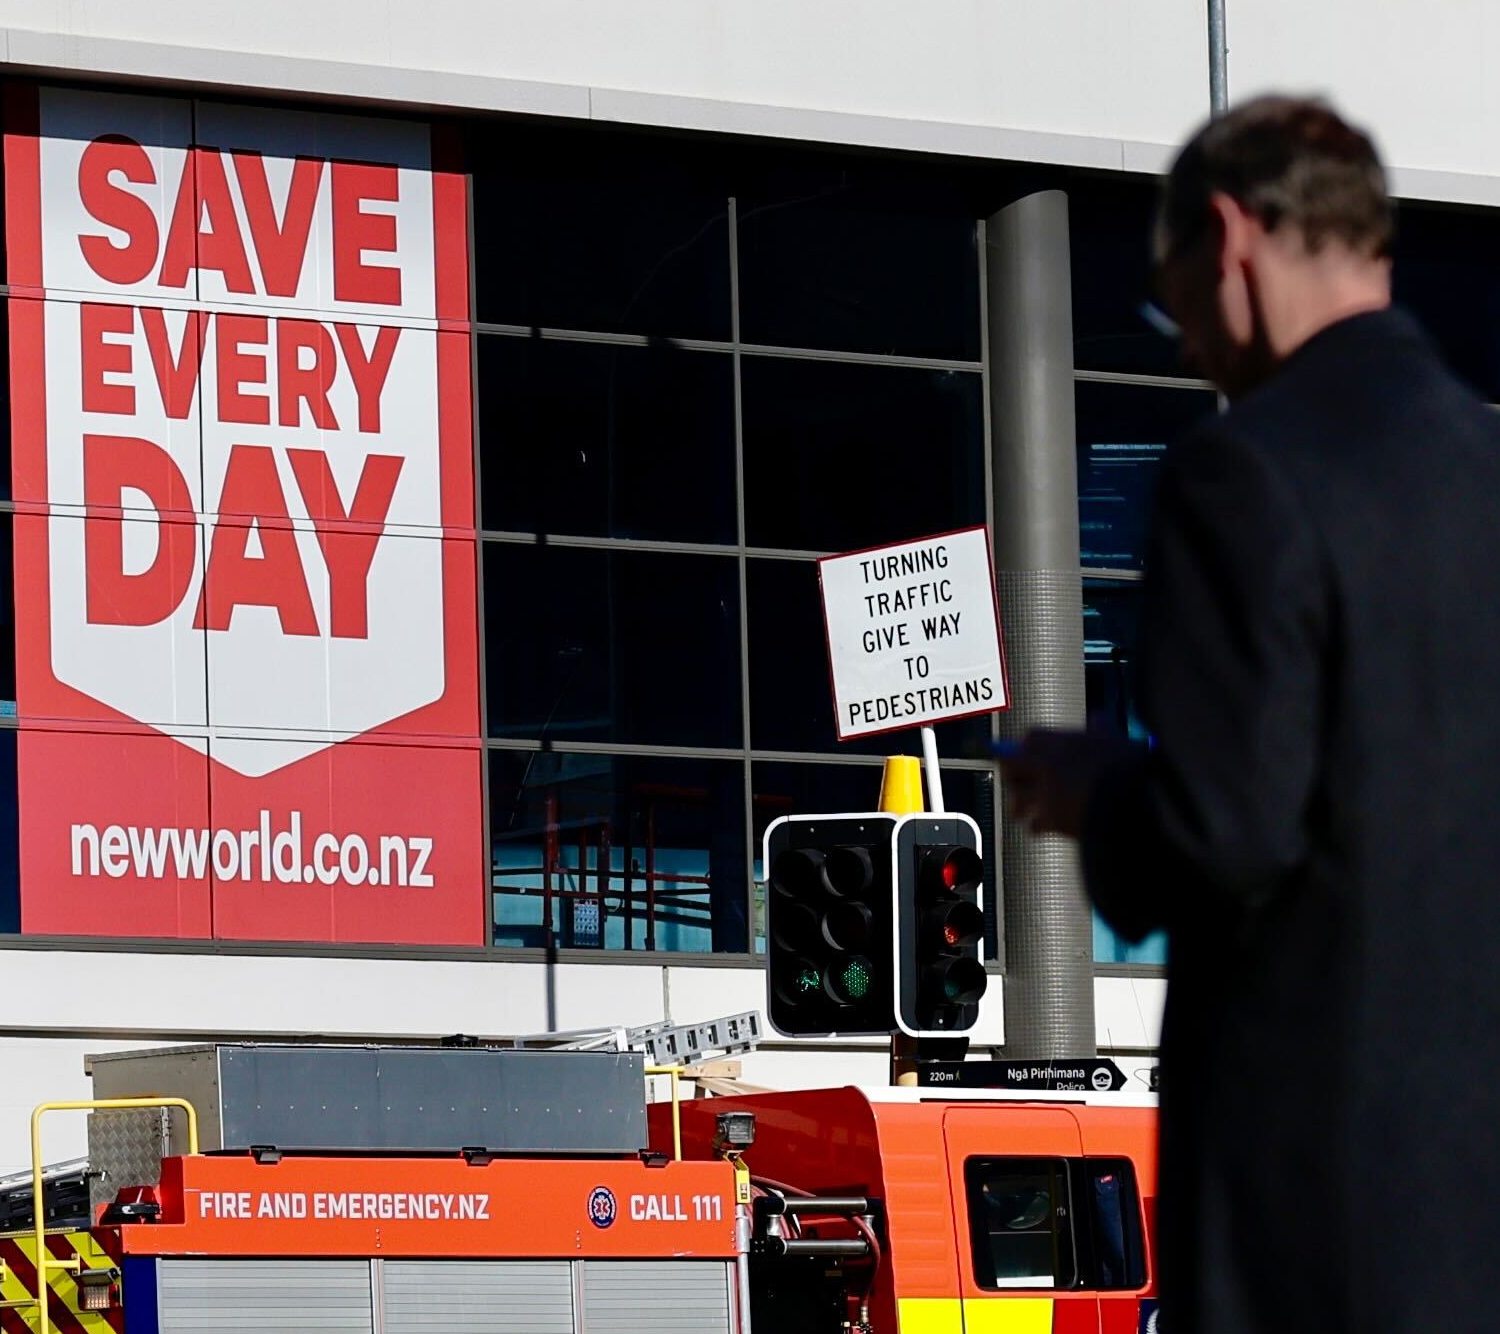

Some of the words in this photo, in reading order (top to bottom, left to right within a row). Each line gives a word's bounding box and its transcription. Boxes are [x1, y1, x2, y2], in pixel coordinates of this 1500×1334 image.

[77, 133, 402, 307] SAVE
[80, 301, 403, 434] EVERY
[82, 433, 406, 640] DAY
[860, 545, 949, 584] TURNING
[864, 579, 953, 617] TRAFFIC
[862, 621, 911, 654] GIVE
[921, 612, 961, 641] WAY
[903, 655, 929, 681] TO
[848, 677, 993, 726] PEDESTRIANS
[70, 809, 435, 889] newworld.co.nz
[1030, 1067, 1086, 1080] Pirihimana
[199, 1192, 253, 1219] FIRE
[257, 1192, 307, 1219] AND
[313, 1193, 490, 1220] EMERGENCY.NZ
[630, 1194, 688, 1221] CALL
[692, 1194, 722, 1221] 111
